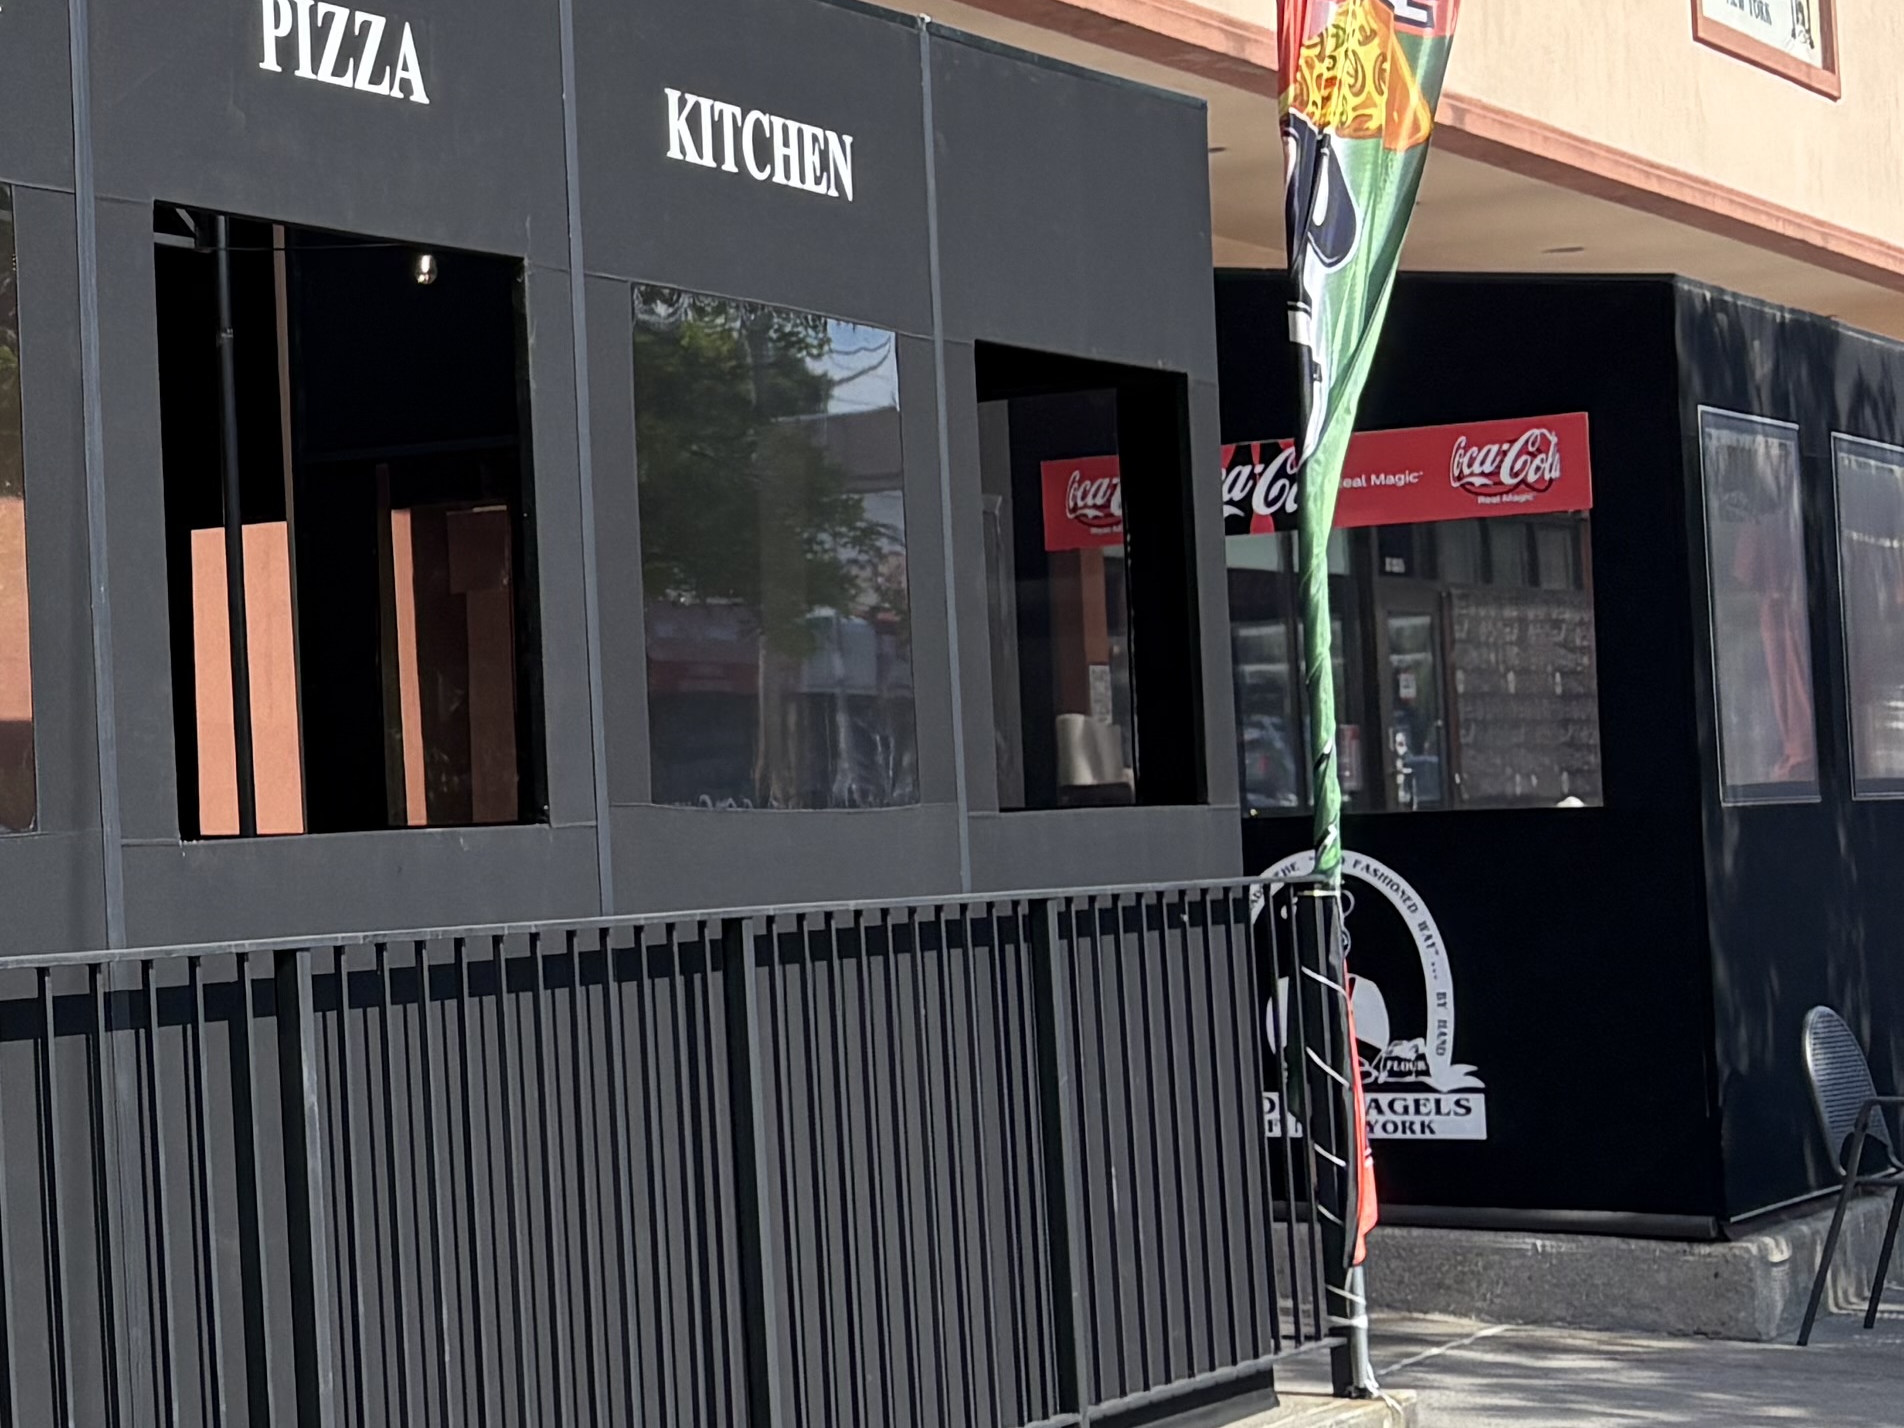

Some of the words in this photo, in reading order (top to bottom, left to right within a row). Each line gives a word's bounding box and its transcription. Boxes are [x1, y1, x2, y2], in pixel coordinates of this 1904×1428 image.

[664, 87, 853, 202] KITCHEN
[1339, 474, 1366, 489] eal
[1449, 427, 1561, 488] Coca-Cola
[1352, 858, 1419, 915] FASHIONED
[1366, 1097, 1473, 1117] AGELS
